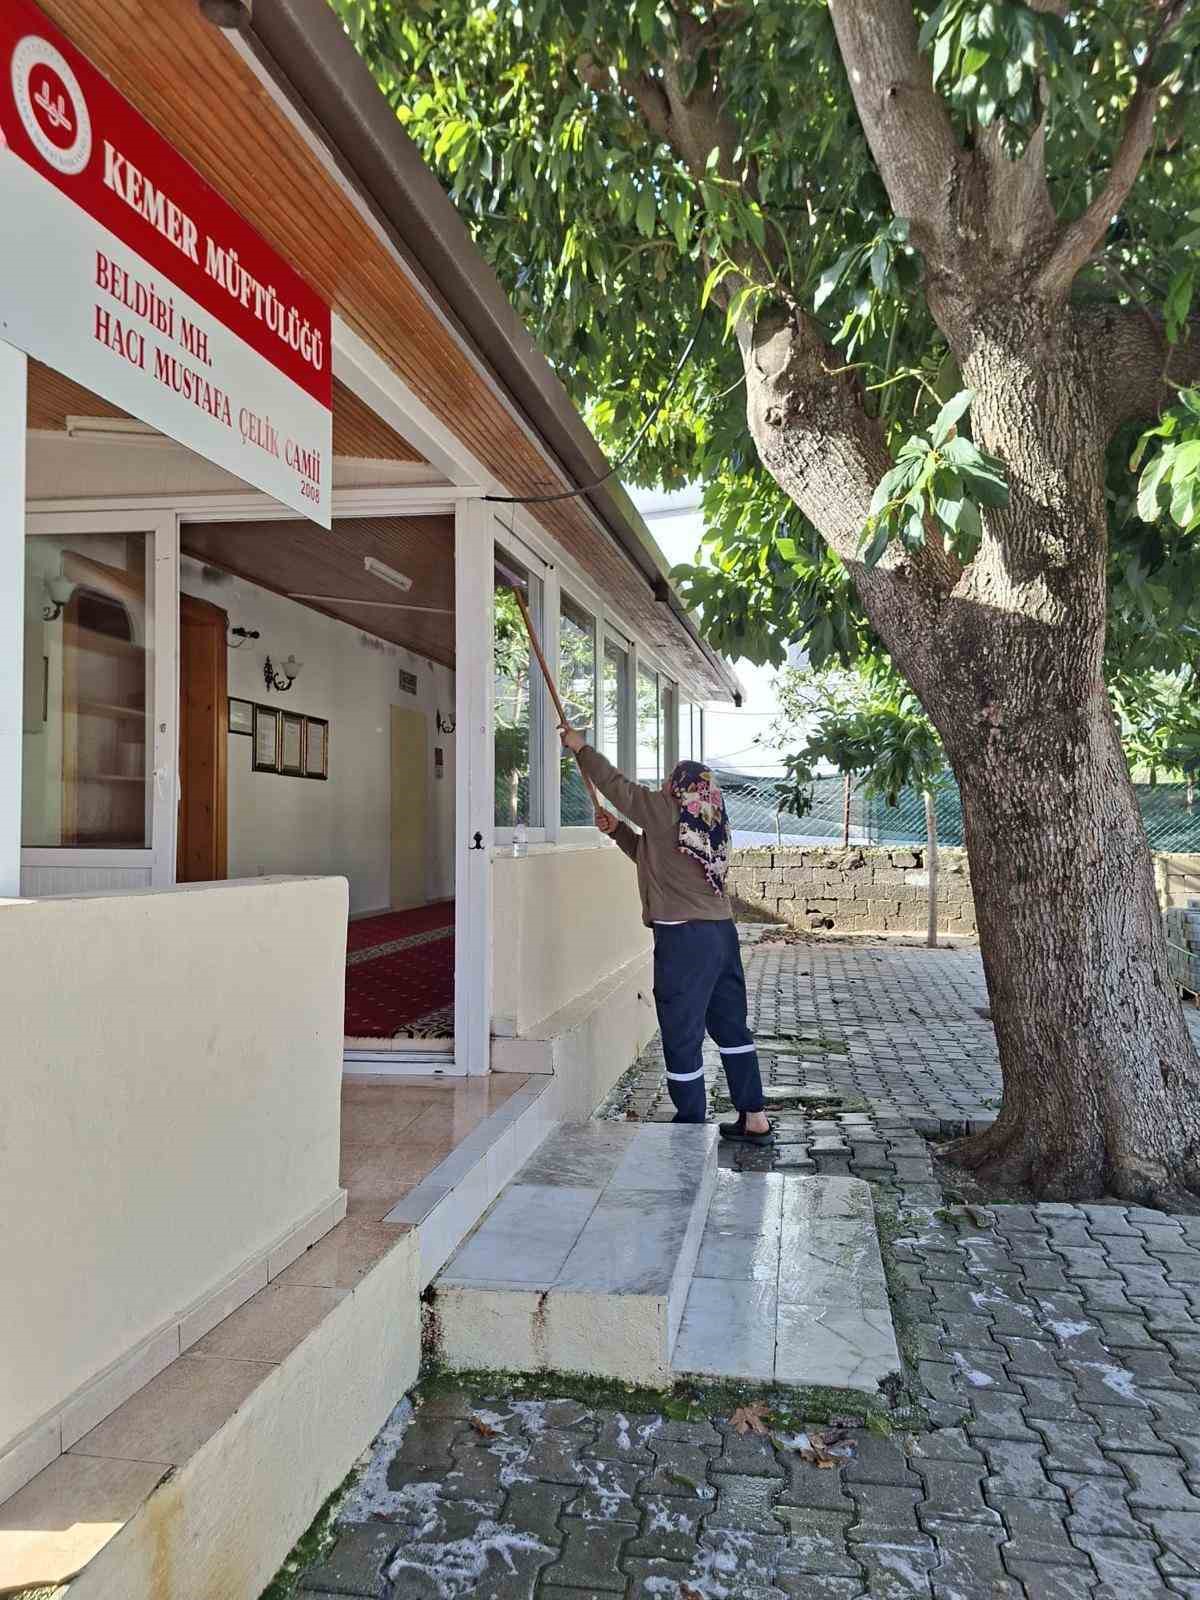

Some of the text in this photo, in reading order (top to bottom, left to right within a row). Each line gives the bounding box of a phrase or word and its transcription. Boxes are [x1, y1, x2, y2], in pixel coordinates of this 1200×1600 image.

[95, 250, 212, 368] BELDİBİ MH.
[102, 139, 322, 370] KEMER MÜFTÜLÜĞÜ
[94, 304, 320, 485] HACI MUSTAFA ÇELİK CAMİİ
[300, 480, 320, 504] 2008
